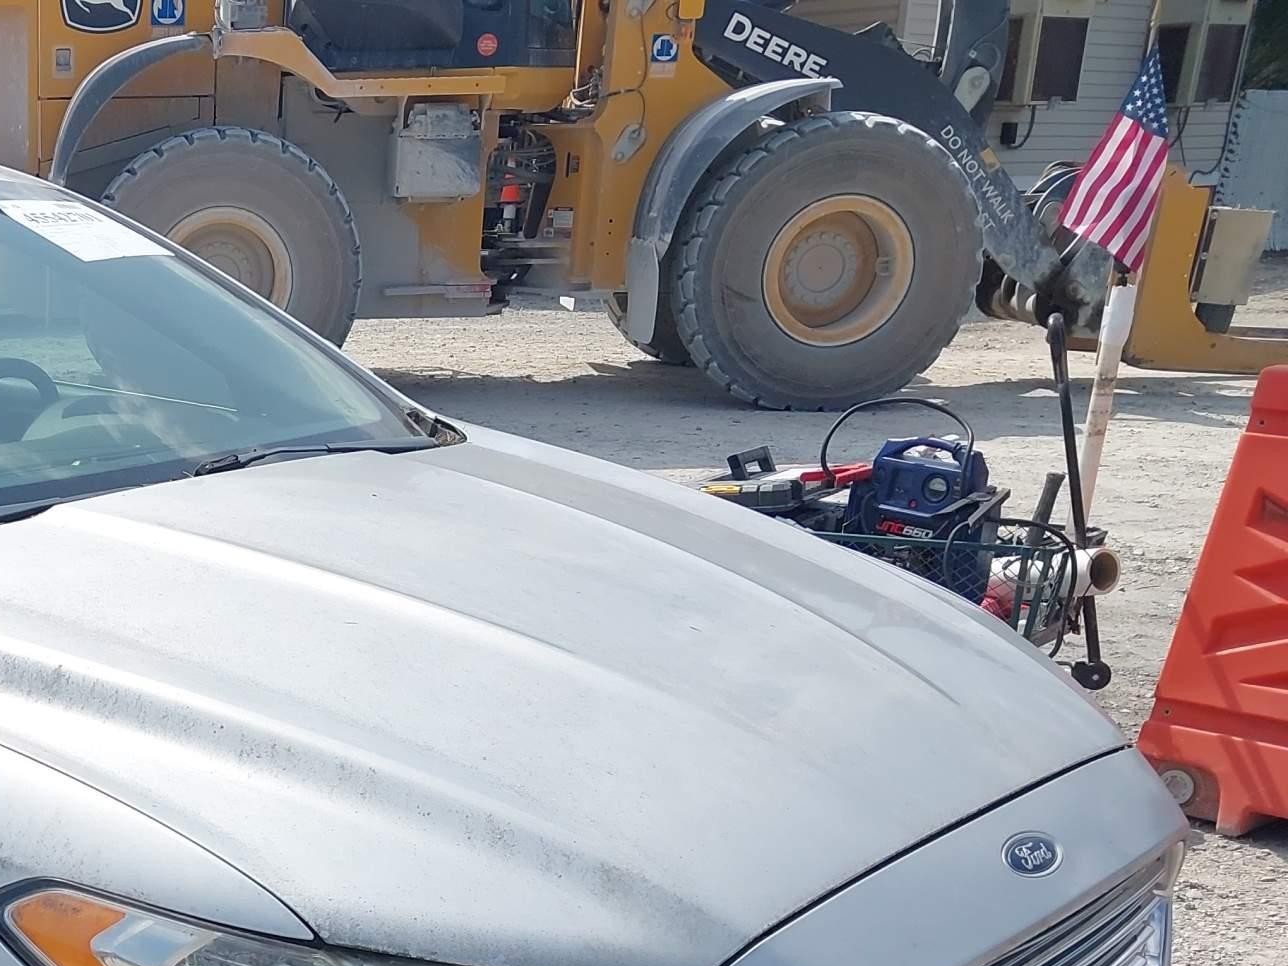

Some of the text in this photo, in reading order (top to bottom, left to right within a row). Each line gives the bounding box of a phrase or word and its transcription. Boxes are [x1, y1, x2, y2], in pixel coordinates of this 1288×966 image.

[723, 11, 828, 79] DEERE
[940, 125, 962, 150] DO
[957, 148, 987, 182] NOT
[982, 180, 1015, 225] WALK
[1014, 842, 1053, 870] Ford
